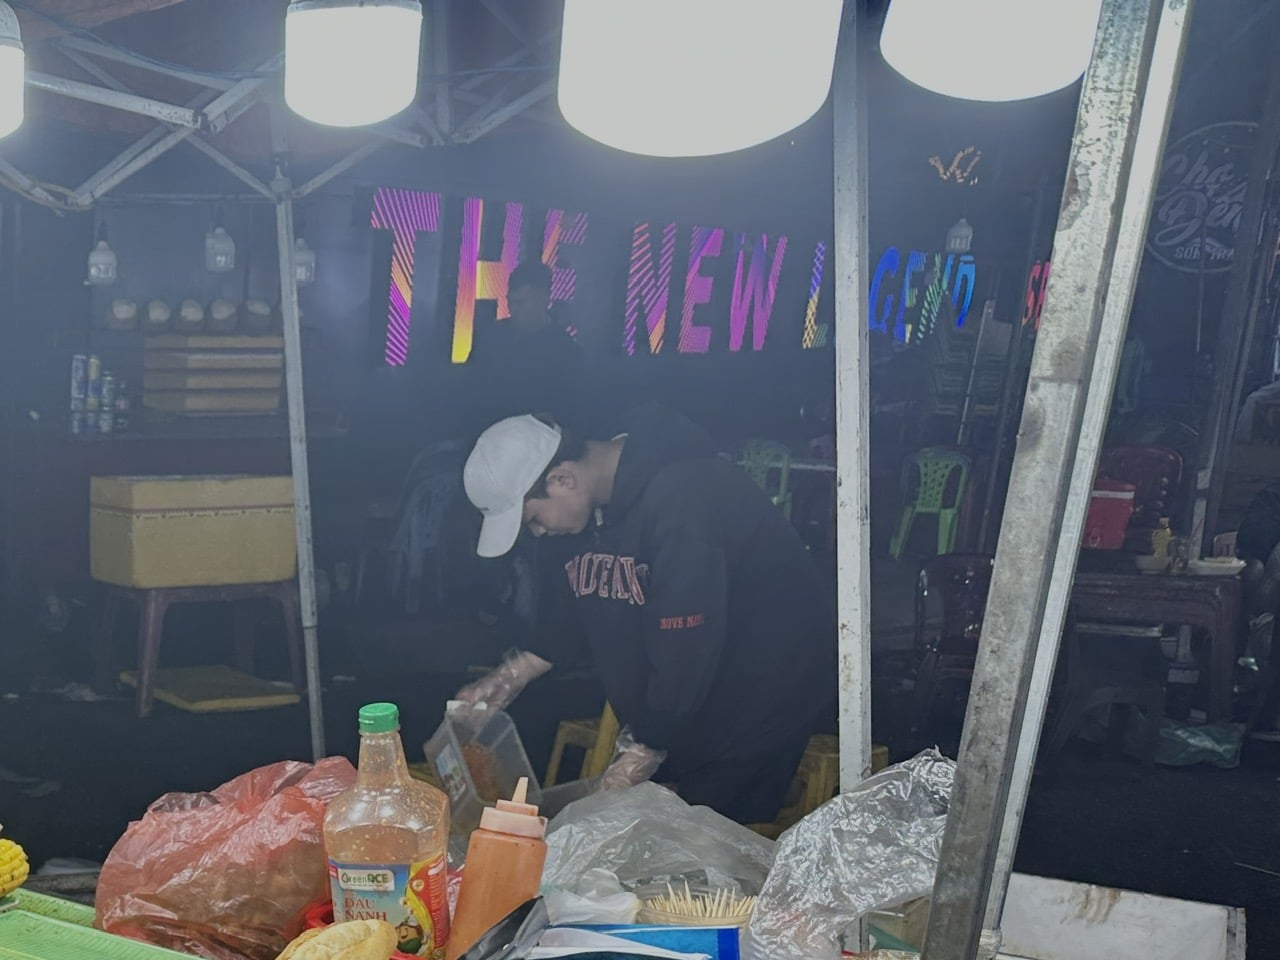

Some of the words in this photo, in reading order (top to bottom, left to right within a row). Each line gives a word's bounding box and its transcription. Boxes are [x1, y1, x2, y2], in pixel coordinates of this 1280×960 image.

[371, 186, 590, 367] THE
[624, 221, 789, 357] NEW
[803, 240, 976, 345] LGEND
